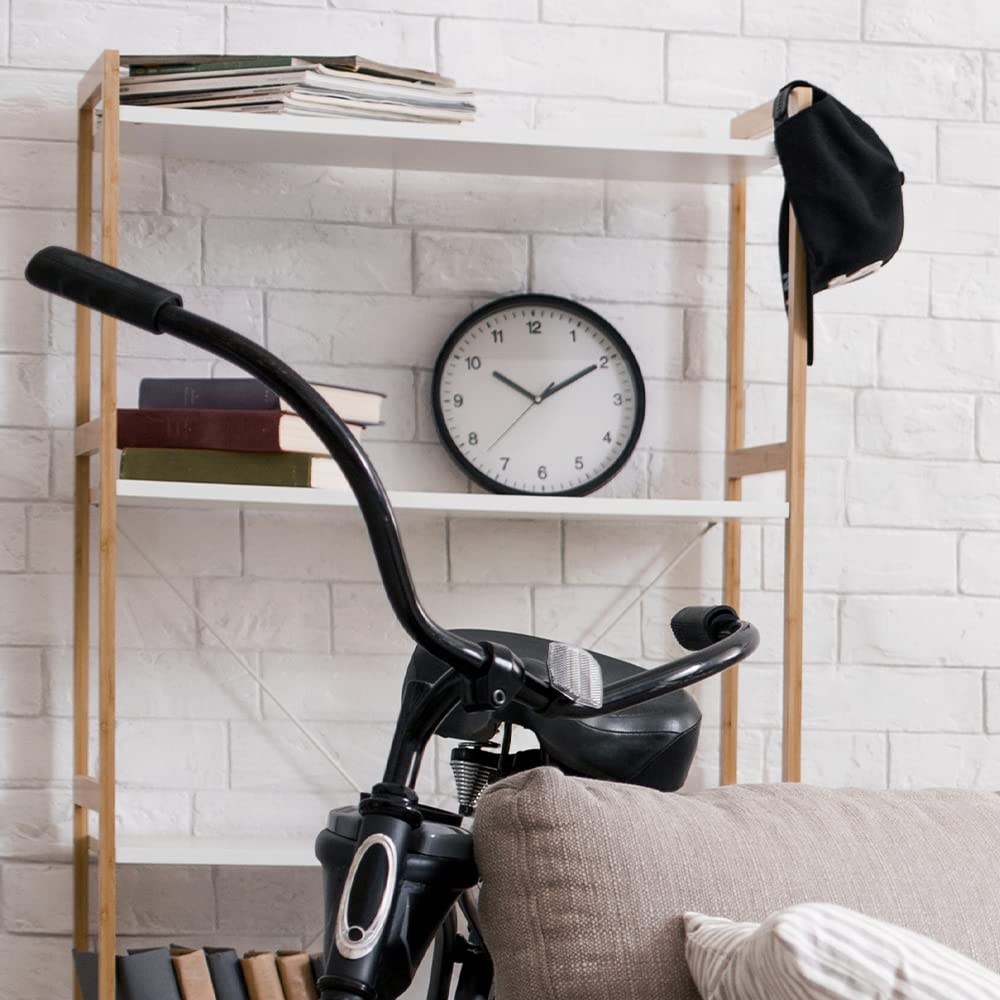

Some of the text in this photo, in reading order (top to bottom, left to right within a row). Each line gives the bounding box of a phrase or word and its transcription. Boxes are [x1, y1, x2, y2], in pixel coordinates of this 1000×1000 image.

[526, 320, 542, 335] 12
[491, 329, 504, 343] 11
[569, 330, 577, 342] 1
[465, 355, 482, 370] 10
[599, 355, 609, 369] 2
[453, 394, 464, 408] 9
[612, 393, 623, 407] 3
[467, 432, 478, 446] 8
[602, 431, 613, 444] 4
[499, 457, 510, 471] 7
[574, 456, 585, 470] 5
[537, 466, 548, 480] 6
